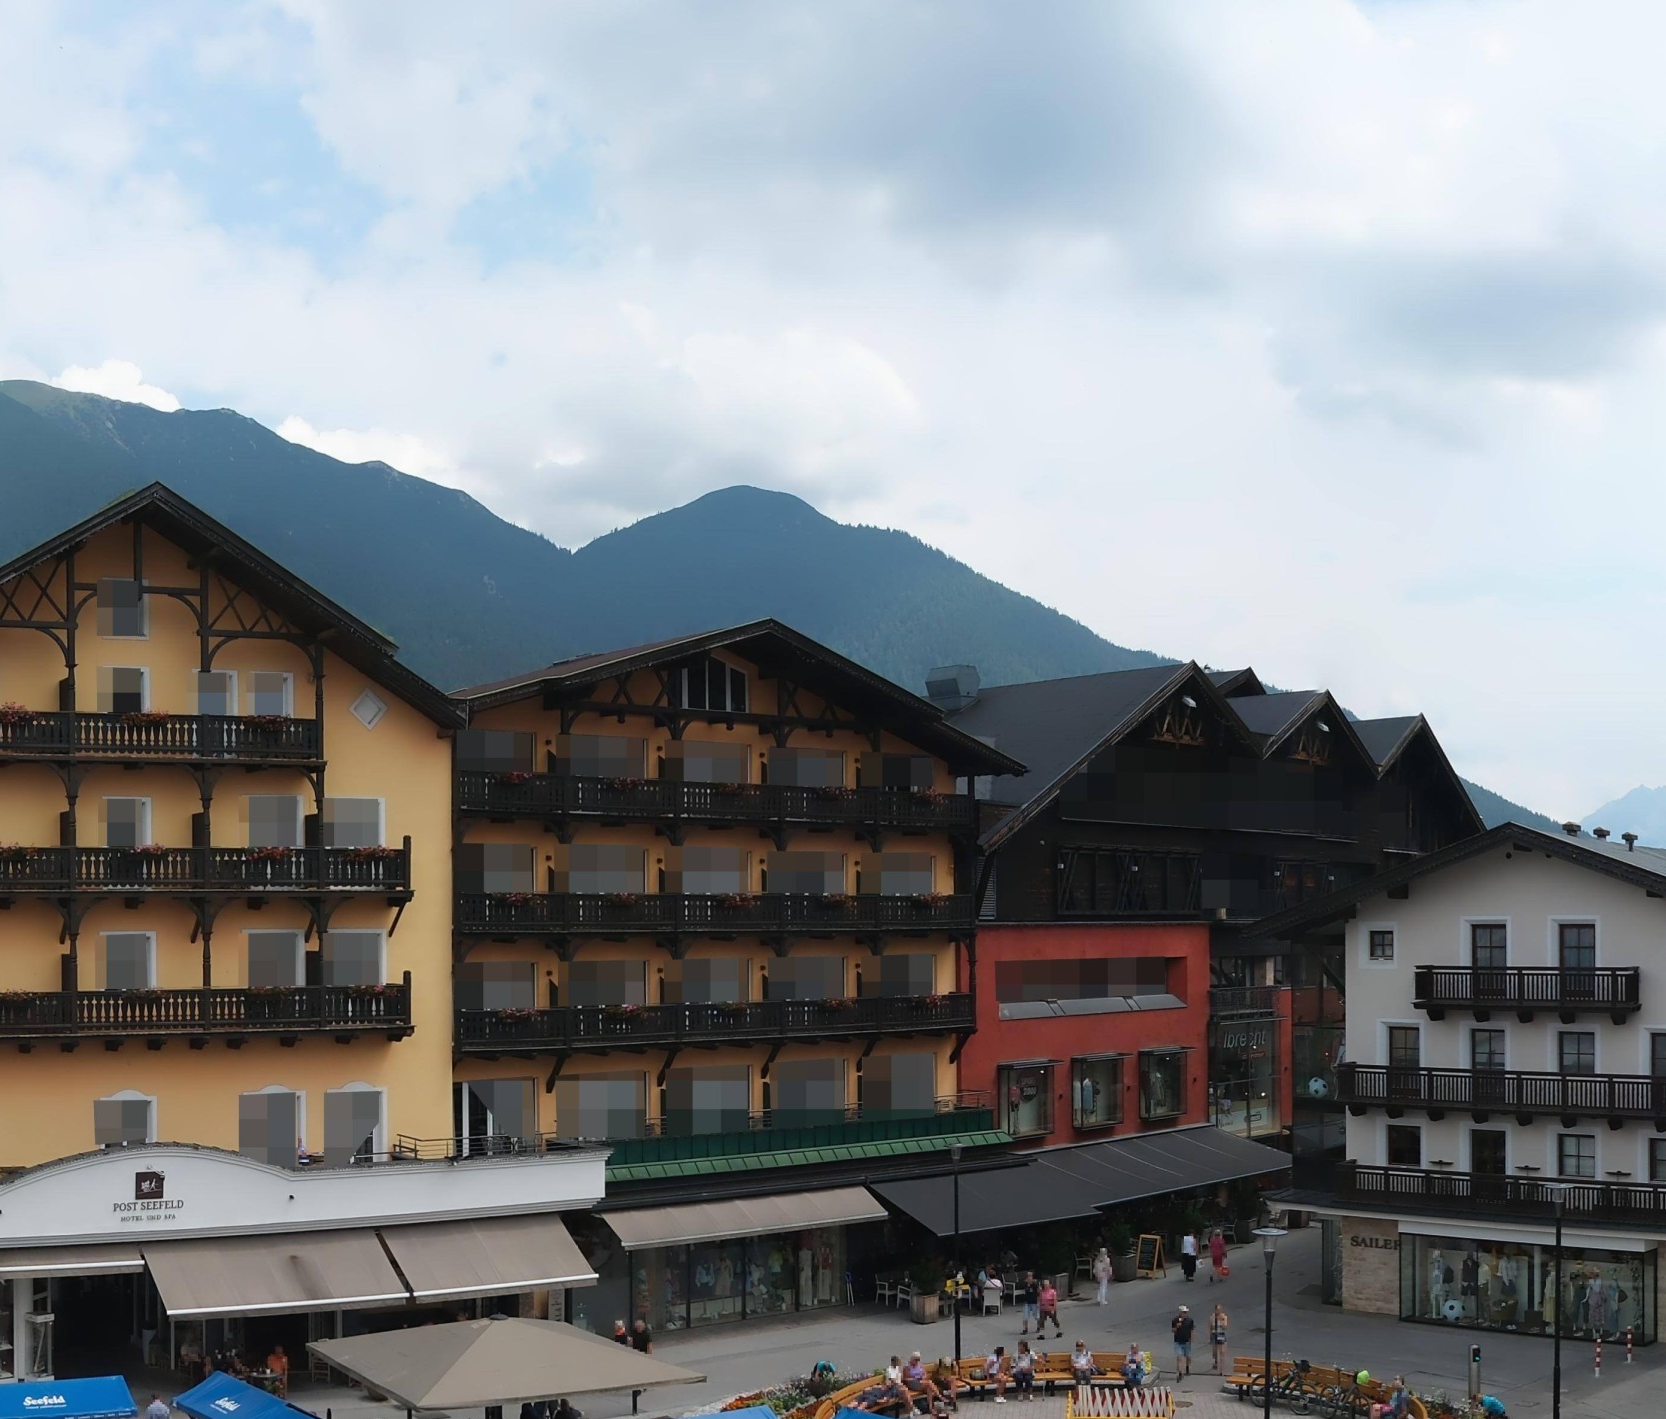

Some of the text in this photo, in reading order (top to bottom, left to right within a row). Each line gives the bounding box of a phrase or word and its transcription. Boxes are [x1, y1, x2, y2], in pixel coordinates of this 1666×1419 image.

[113, 1200, 184, 1212] POST SEEFELD
[23, 1395, 66, 1407] Seefeld
